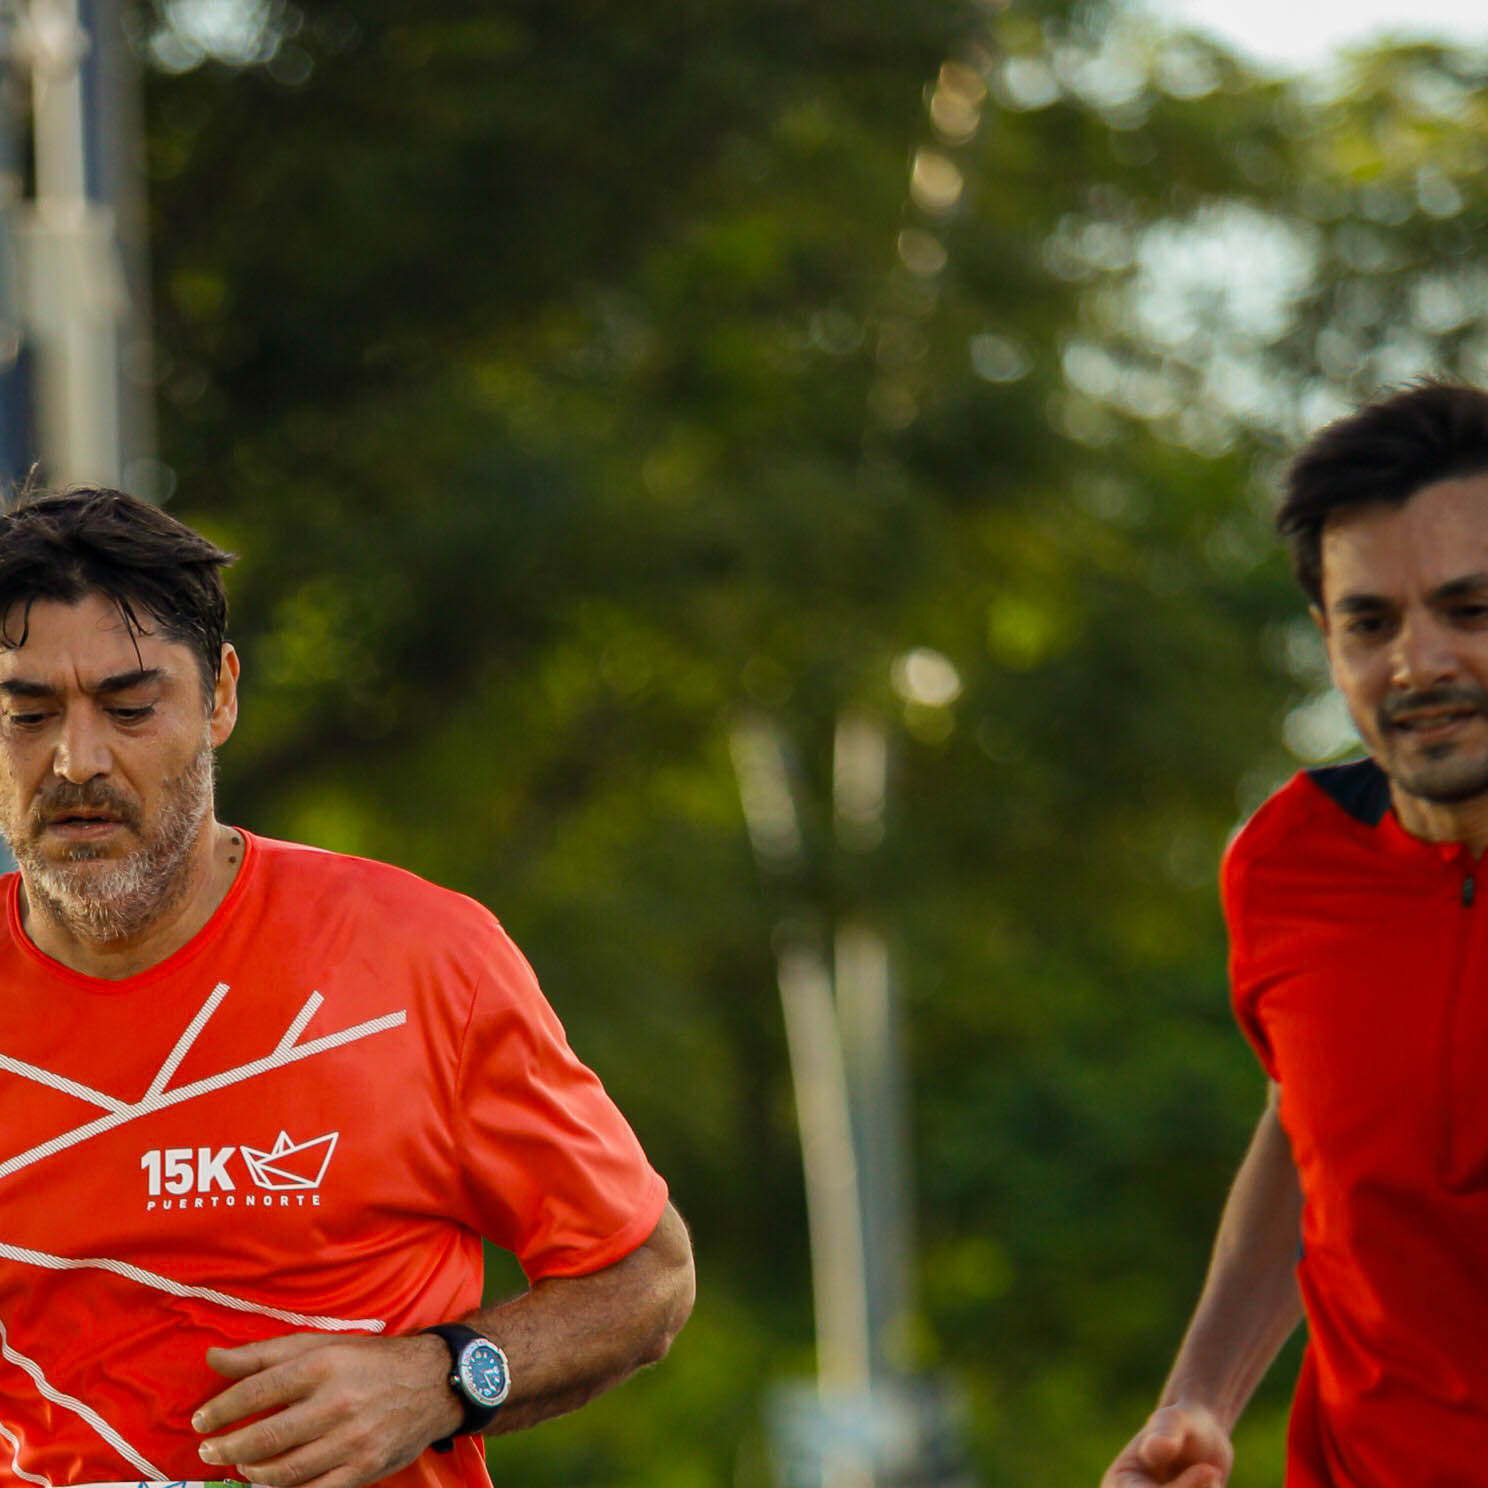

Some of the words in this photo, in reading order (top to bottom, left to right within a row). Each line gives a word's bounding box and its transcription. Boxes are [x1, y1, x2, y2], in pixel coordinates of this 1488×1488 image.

[141, 1146, 236, 1196] 15K
[147, 1197, 235, 1211] PUERTO
[245, 1195, 320, 1207] NORTE
